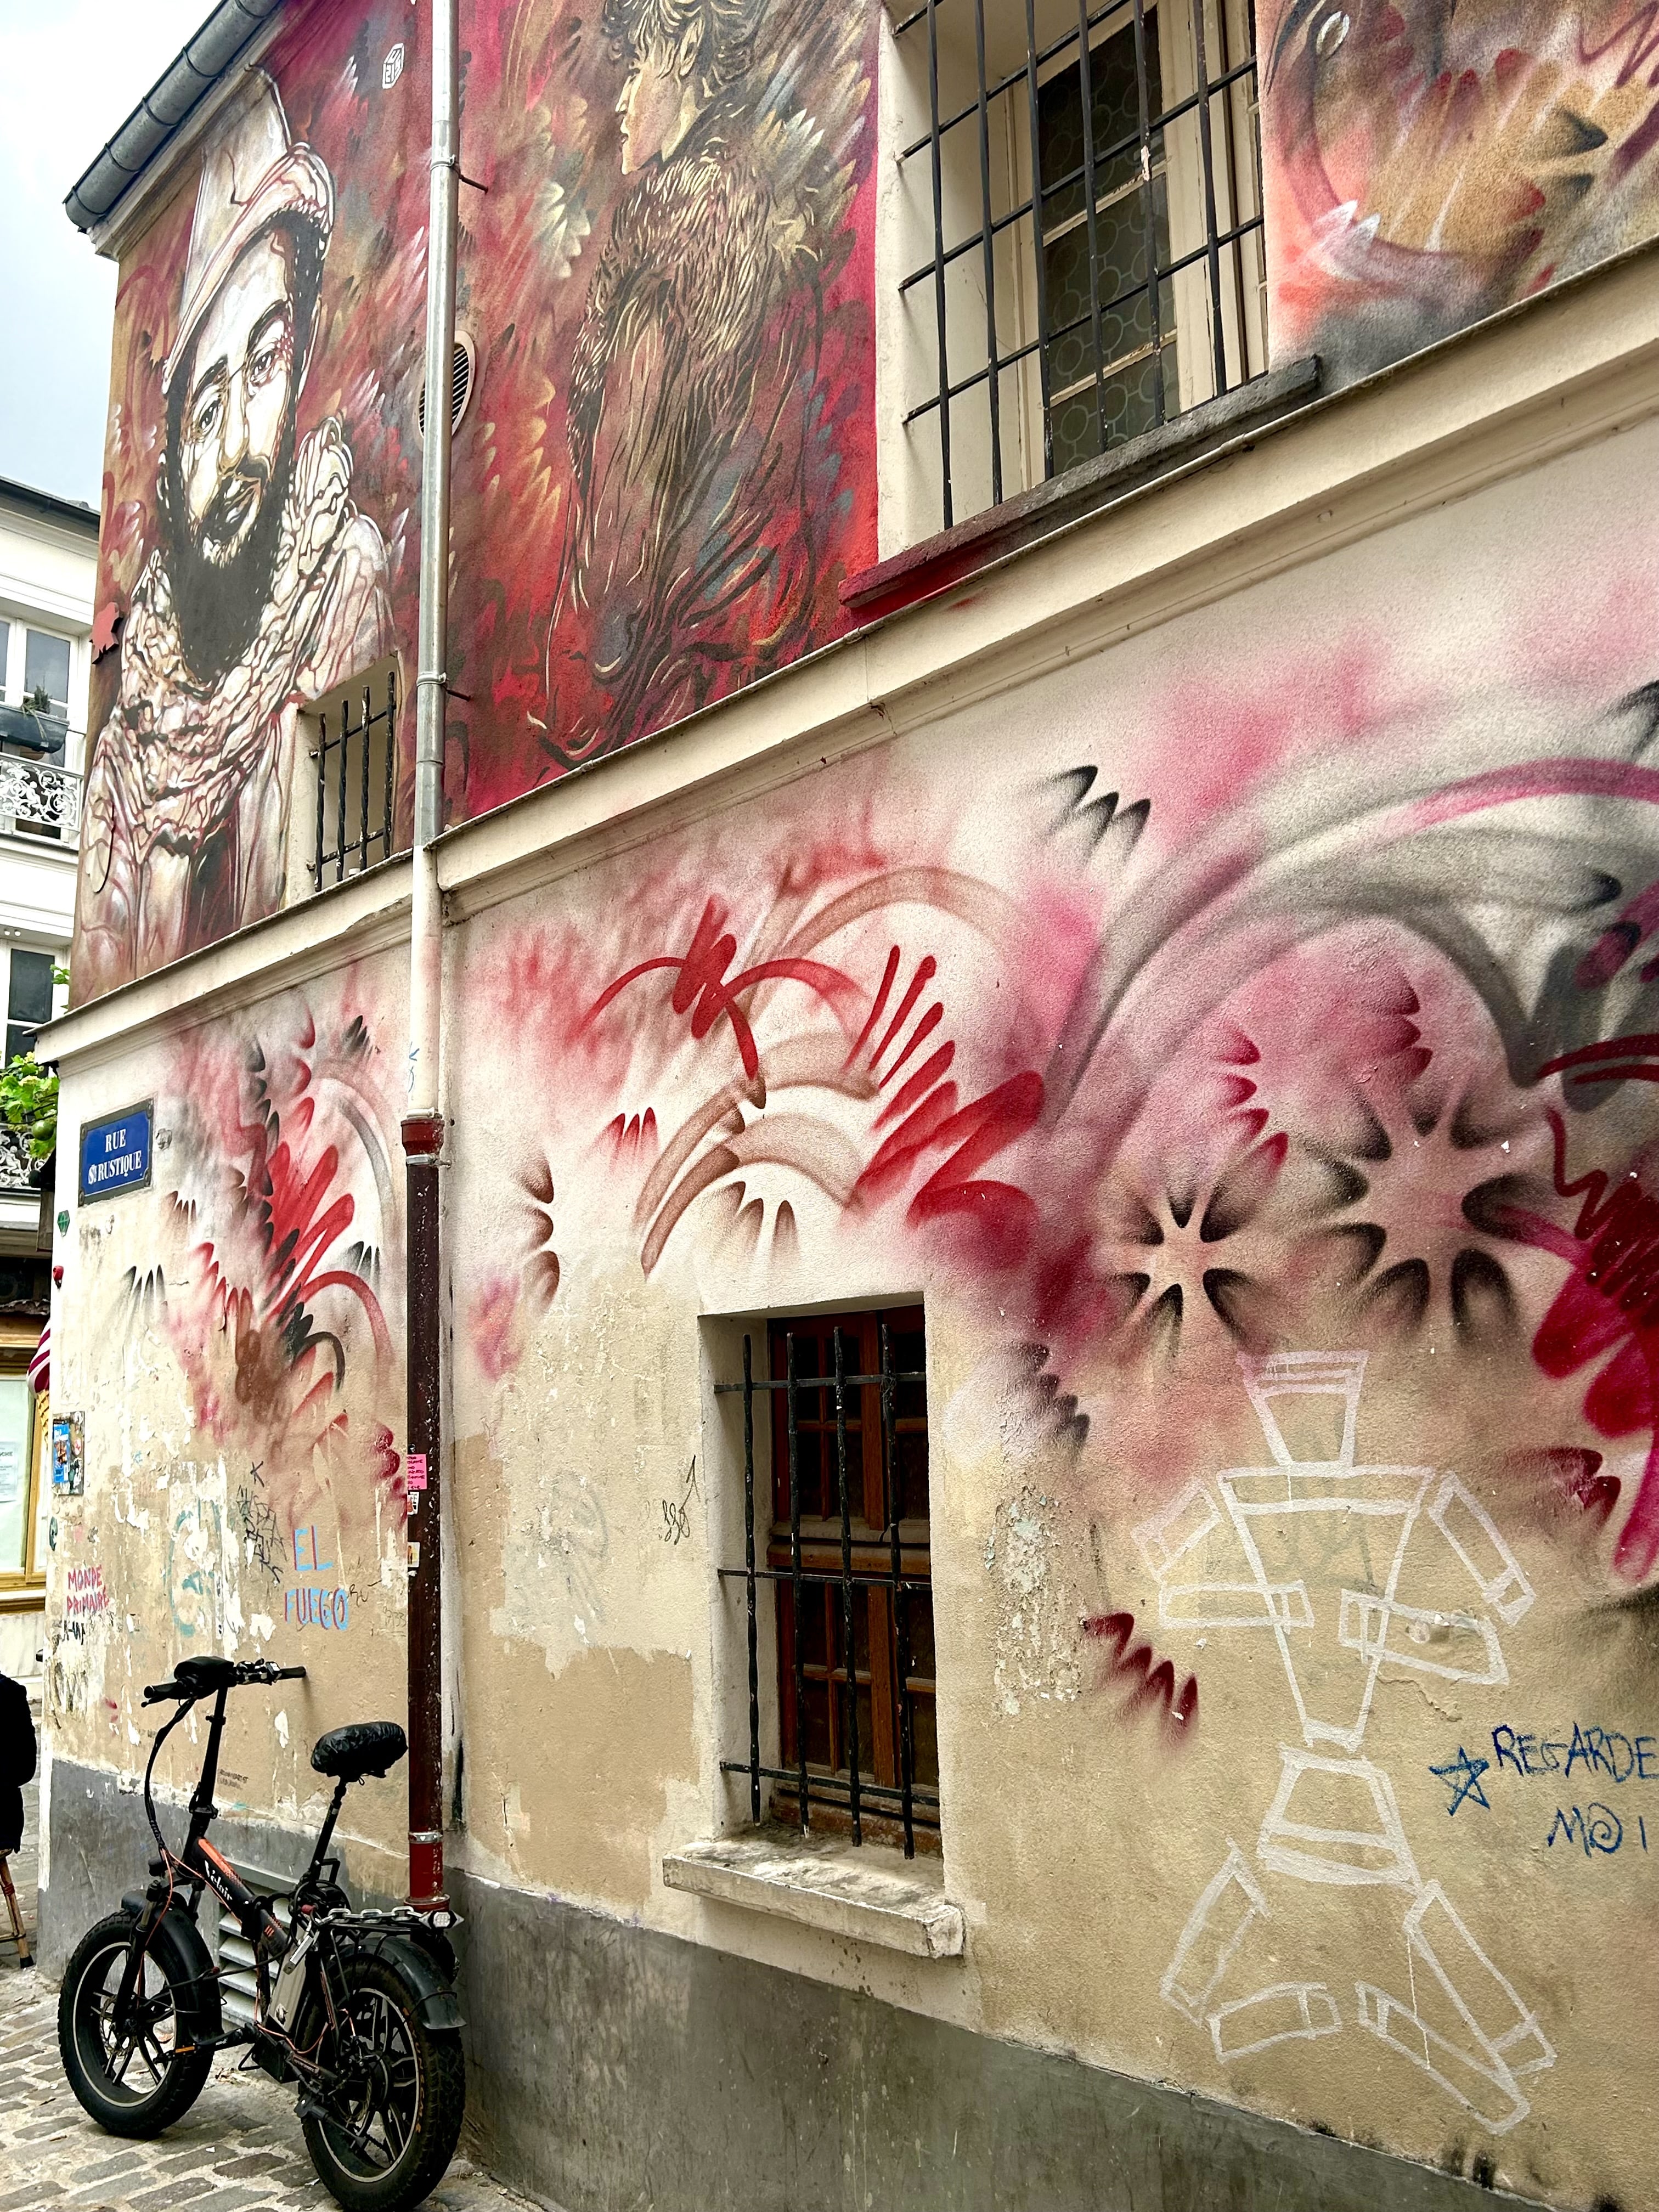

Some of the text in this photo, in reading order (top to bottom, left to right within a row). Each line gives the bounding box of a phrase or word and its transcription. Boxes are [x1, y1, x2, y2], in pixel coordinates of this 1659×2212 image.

[105, 1128, 126, 1153] RUE
[97, 1150, 142, 1182] RUSTIQUE
[292, 1525, 334, 1572] EL
[68, 1565, 103, 1592] MONDE
[66, 1584, 110, 1616] PRIMAIRE
[284, 1587, 349, 1630] FUEGO
[1492, 1720, 1659, 1783] REGARDE
